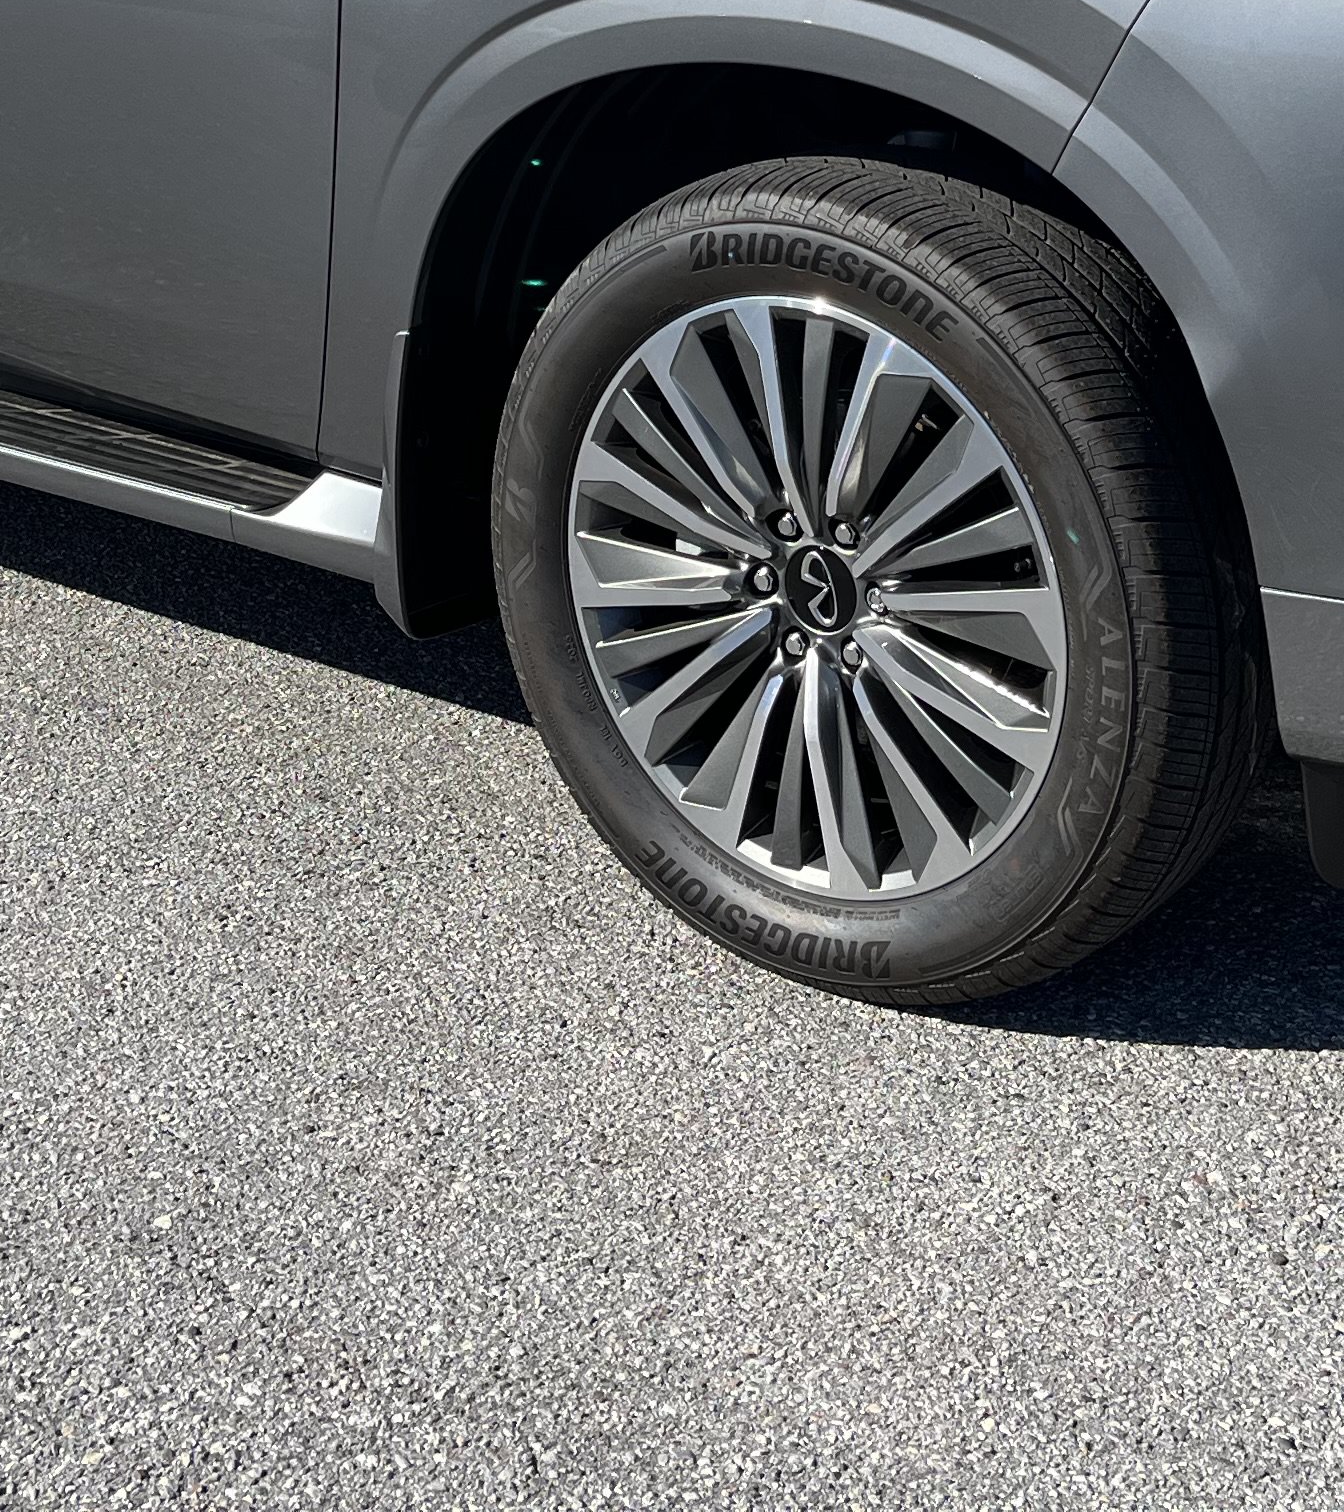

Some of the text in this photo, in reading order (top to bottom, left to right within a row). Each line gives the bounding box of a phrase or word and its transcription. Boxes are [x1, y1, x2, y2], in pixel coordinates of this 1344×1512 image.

[689, 231, 959, 341] BRIDGESTONE
[1077, 618, 1125, 815] ALENZA
[635, 840, 891, 979] BRIDGESTONE
